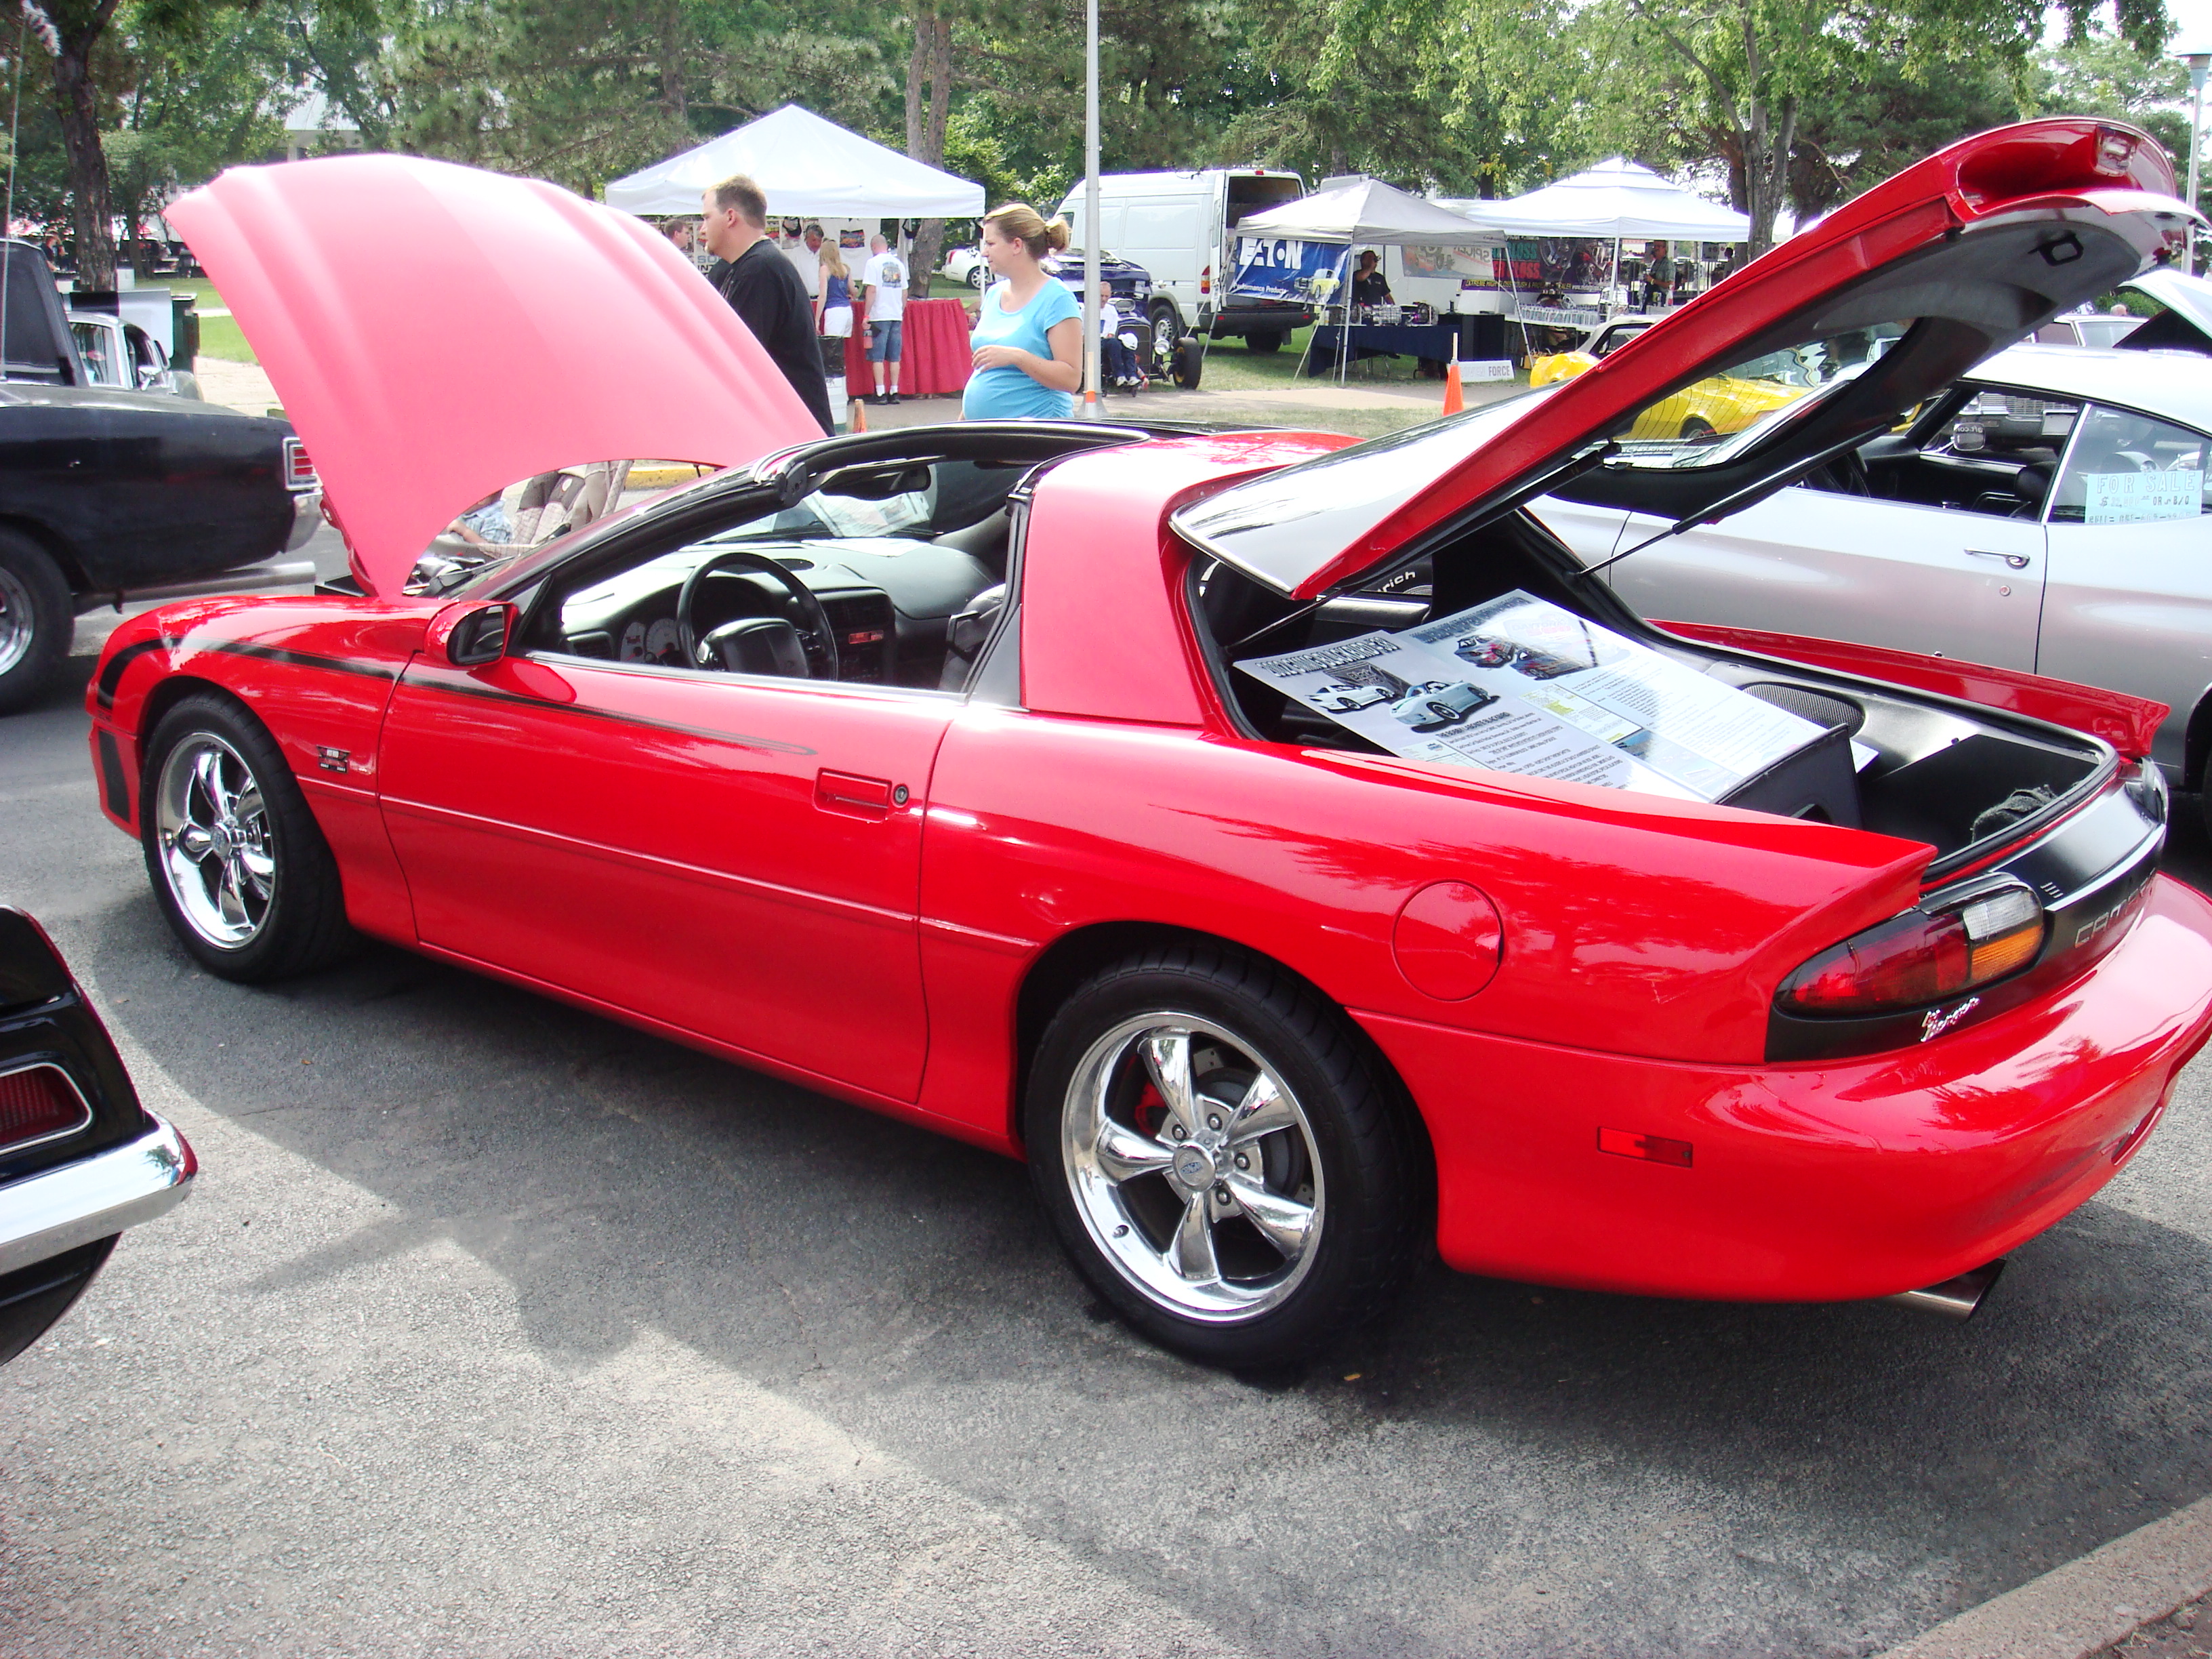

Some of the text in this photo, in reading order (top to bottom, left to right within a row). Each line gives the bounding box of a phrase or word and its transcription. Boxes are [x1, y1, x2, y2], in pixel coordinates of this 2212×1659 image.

[1240, 237, 1303, 270] EATON
[1488, 365, 1511, 377] FORCE
[2097, 472, 2196, 493] FOR SALE
[1376, 571, 1416, 593] rich
[1254, 659, 1300, 677] 2002
[1310, 642, 1382, 668] BLACKBIRD
